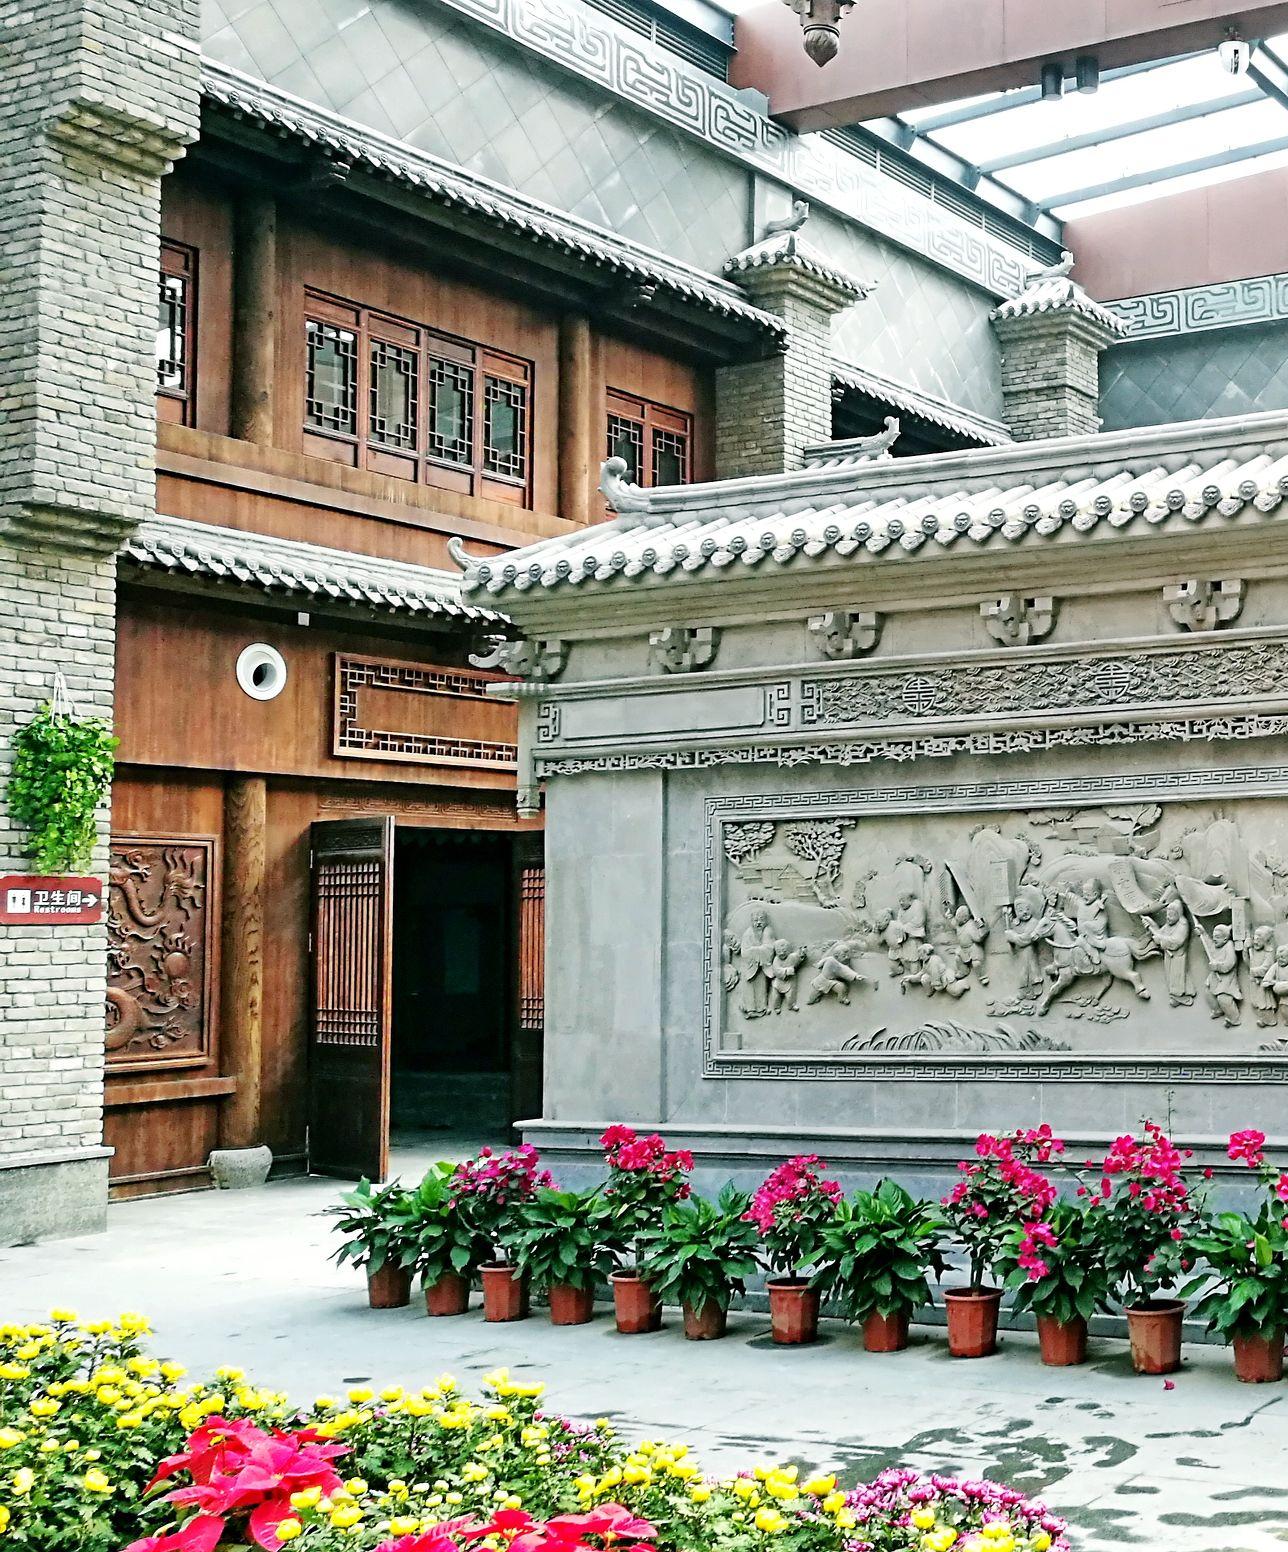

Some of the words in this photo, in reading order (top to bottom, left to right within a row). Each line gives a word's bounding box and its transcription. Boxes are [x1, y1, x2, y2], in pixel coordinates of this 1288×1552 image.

[33, 890, 82, 906] 卫生间
[33, 906, 82, 914] Restrooms
